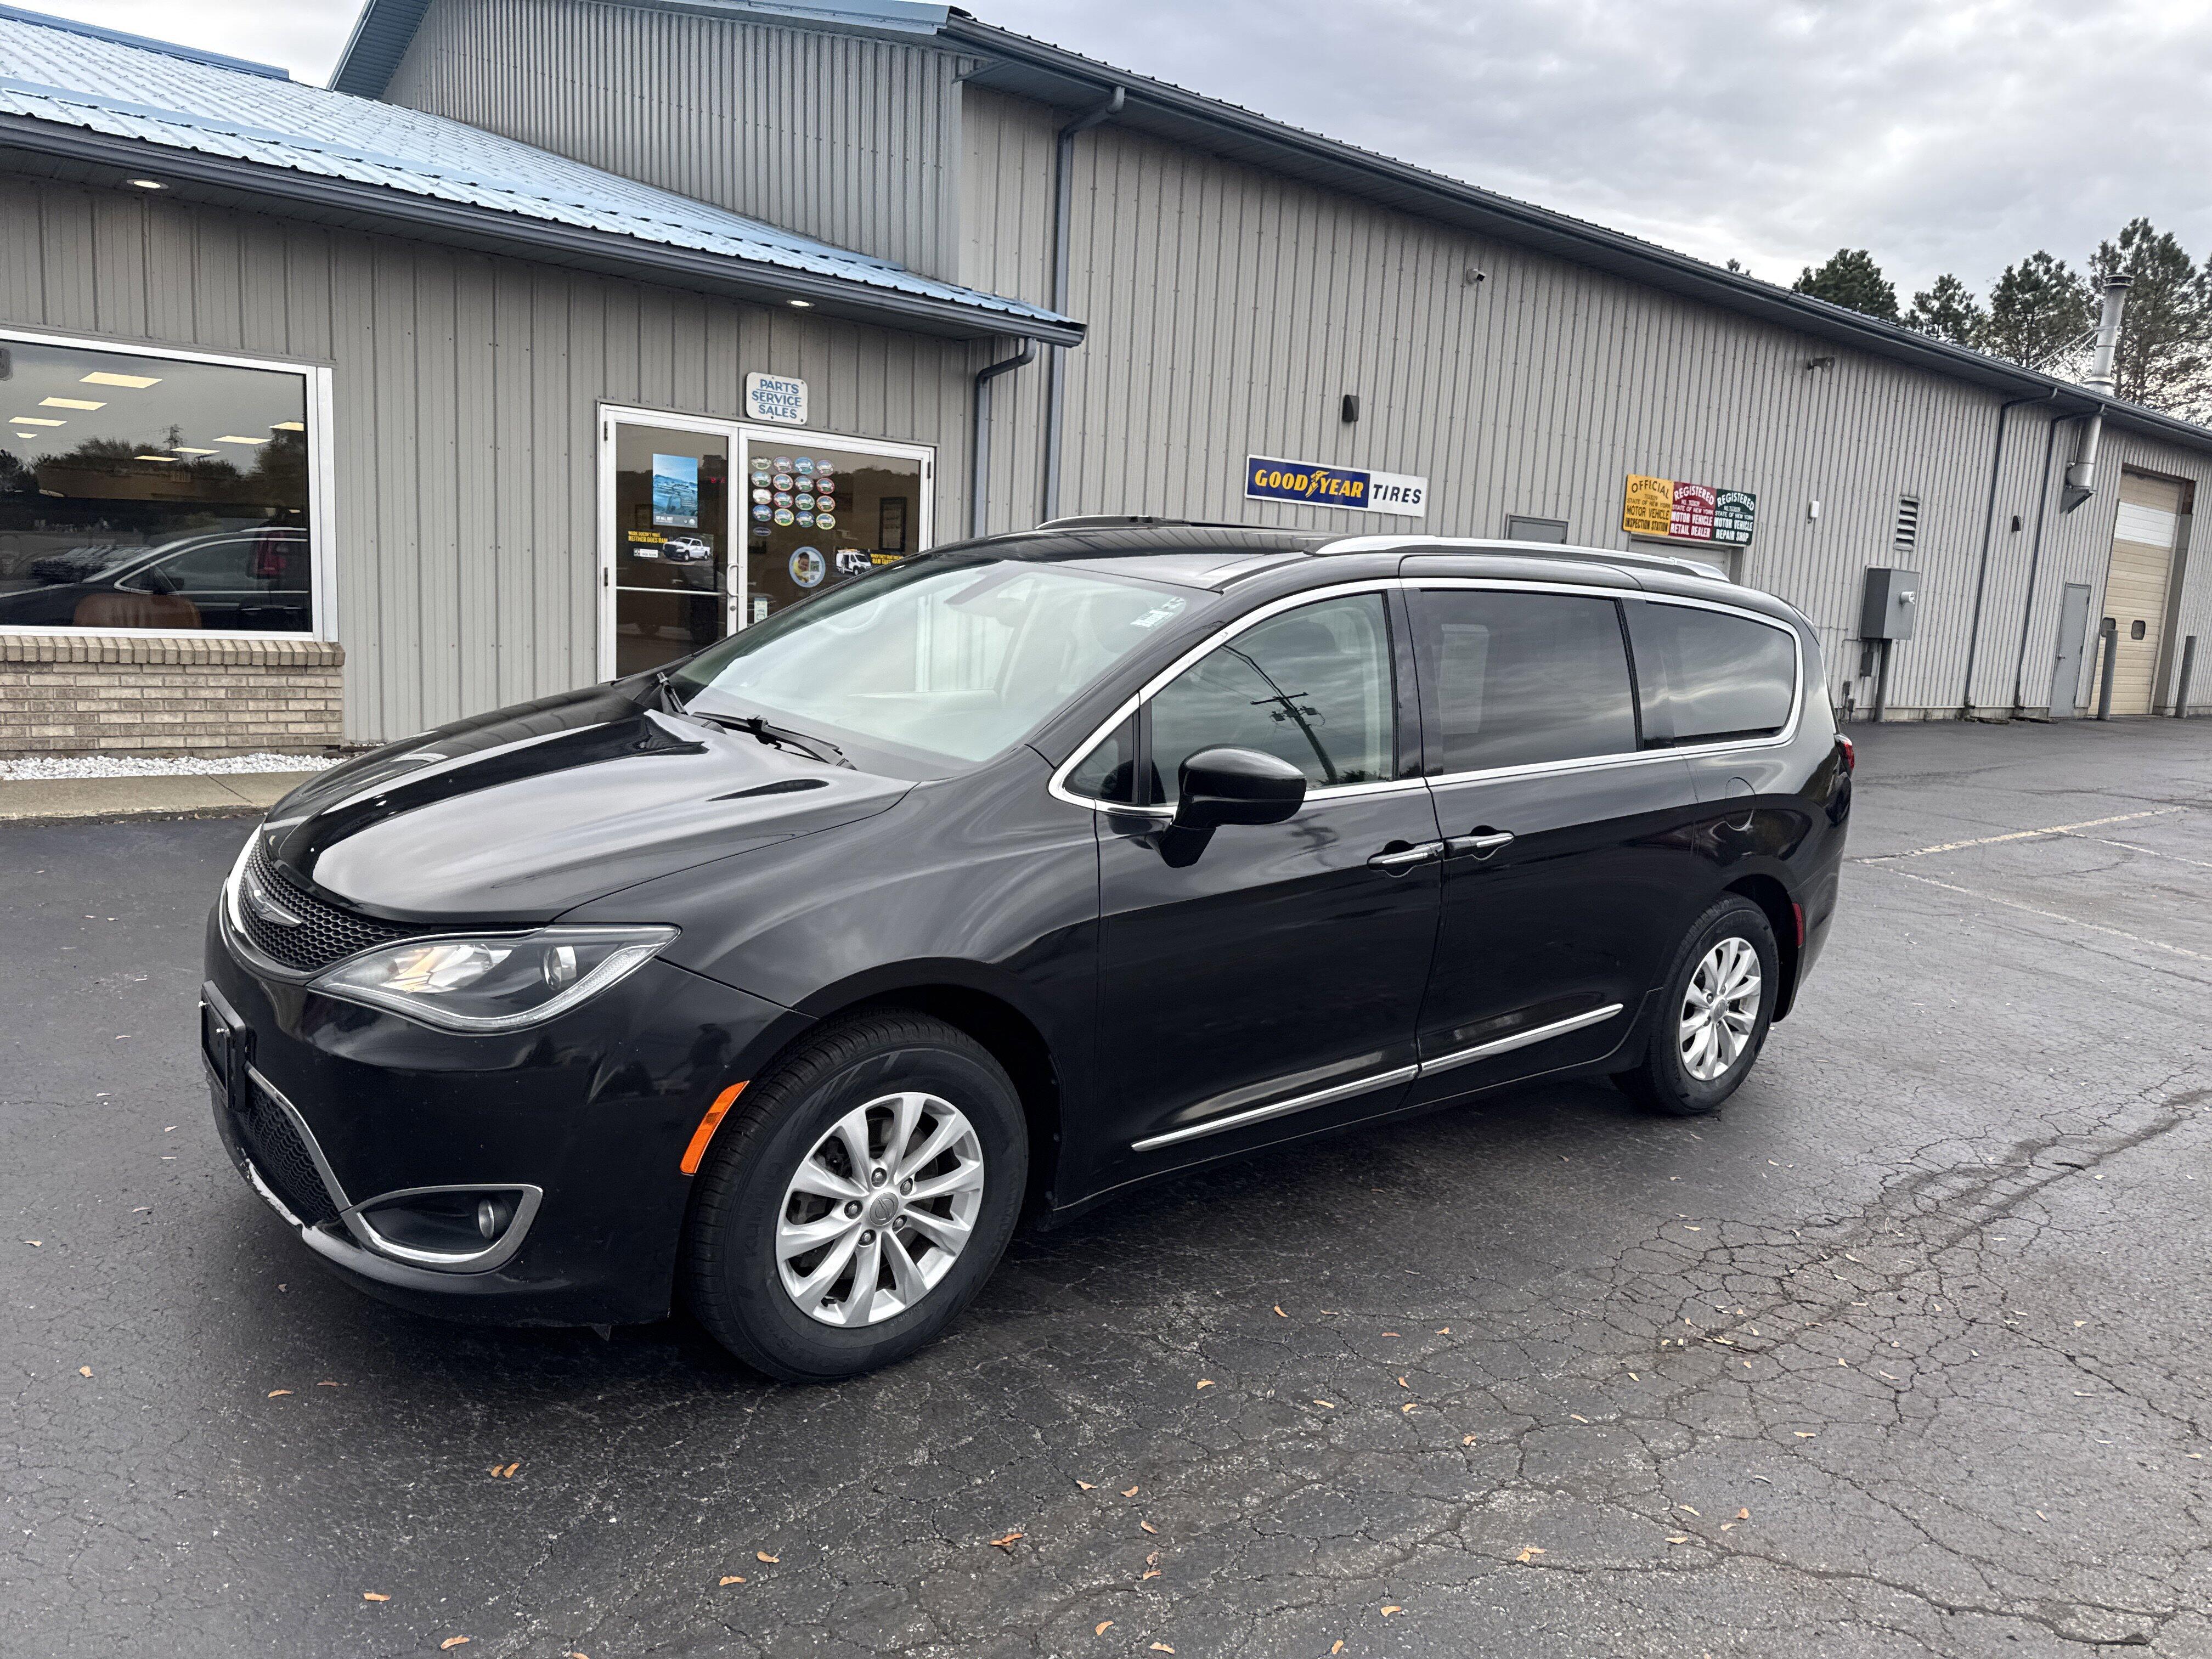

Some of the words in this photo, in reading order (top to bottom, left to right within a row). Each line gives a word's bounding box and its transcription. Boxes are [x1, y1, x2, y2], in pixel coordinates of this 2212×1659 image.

[759, 379, 799, 394] PARTS
[752, 390, 802, 407] SERVICE
[758, 404, 797, 419] SALES
[1255, 469, 1364, 498] GOODYEAR
[1373, 484, 1422, 504] TIRES
[1632, 479, 1669, 499] OFFICIAL
[1674, 486, 1714, 505] REGISTERED
[1717, 492, 1754, 511] REGISTERED
[1627, 505, 1646, 517] MOTOR
[1649, 508, 1669, 520] VEHICLE
[1670, 511, 1690, 523] MOTOR
[1692, 514, 1713, 527] VEHICLE
[1625, 517, 1650, 530] INSPECTION
[1651, 521, 1668, 532] STATION
[1670, 523, 1690, 535] RETAIL
[1690, 526, 1711, 538] DEALER
[1713, 517, 1733, 529] MOTOR
[1734, 520, 1753, 532] VEHICLE
[1716, 529, 1735, 541] REPAIR
[1736, 531, 1750, 543] SHOP
